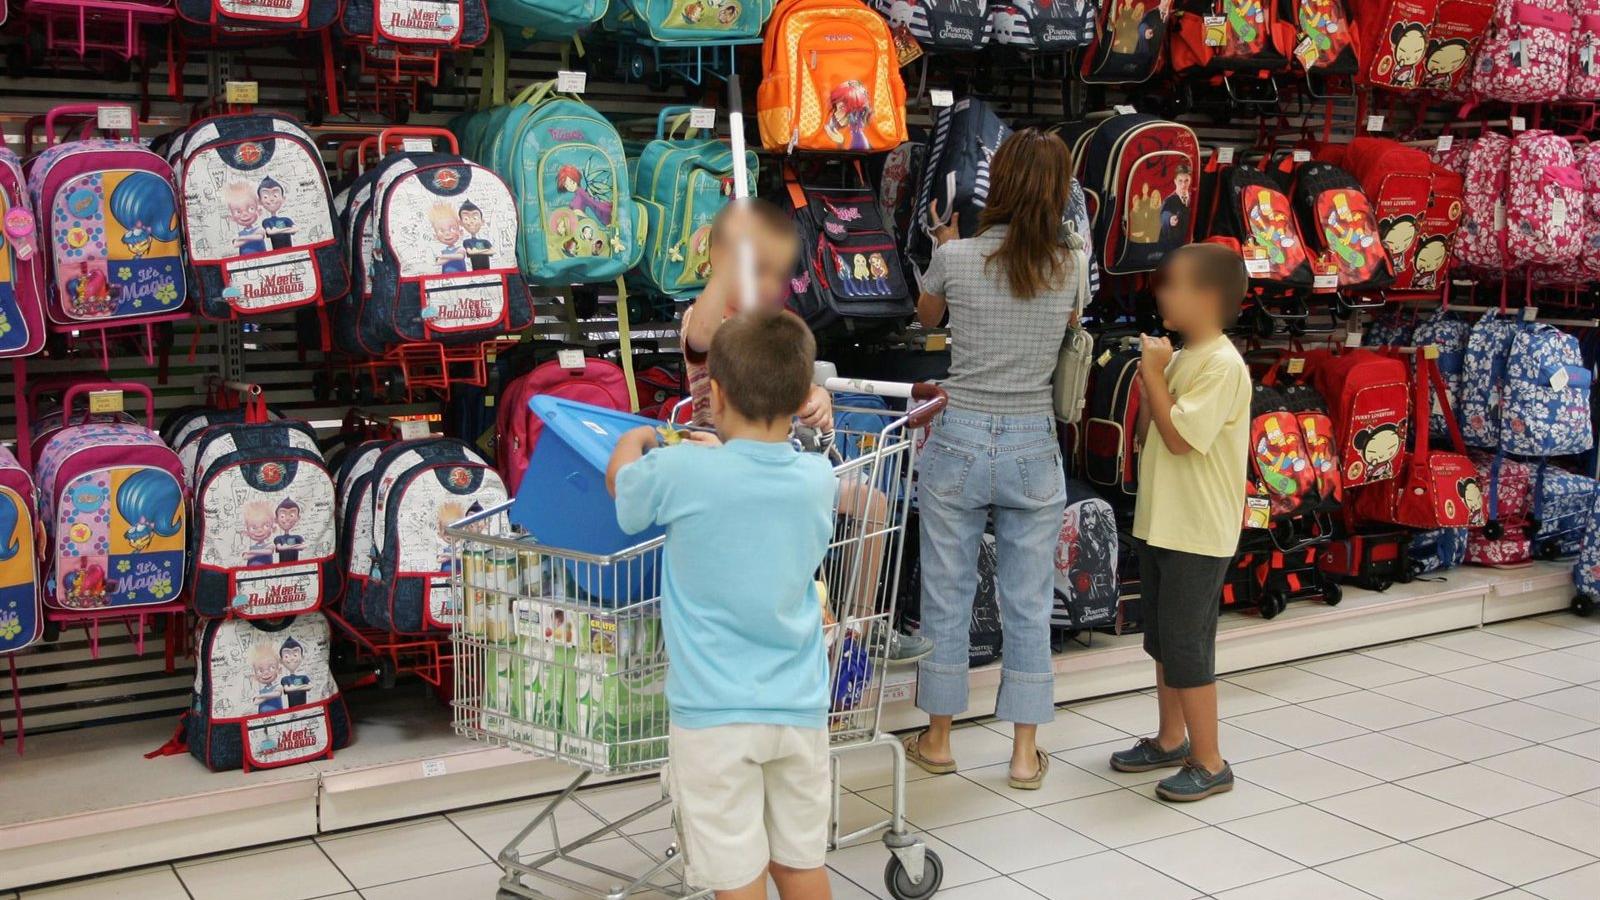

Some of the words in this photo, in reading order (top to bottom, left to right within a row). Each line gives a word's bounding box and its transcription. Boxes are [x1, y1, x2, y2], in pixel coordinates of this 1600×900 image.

[411, 8, 439, 21] Meet
[264, 272, 294, 288] Meet
[118, 274, 175, 304] Magic
[243, 281, 304, 299] Robinsons
[457, 298, 485, 310] Meet
[439, 305, 493, 320] Robinsons
[112, 569, 172, 595] Magic
[270, 583, 297, 597] Meet
[249, 592, 307, 607] Robinsons
[281, 727, 307, 741] Meet
[277, 735, 317, 751] binsons
